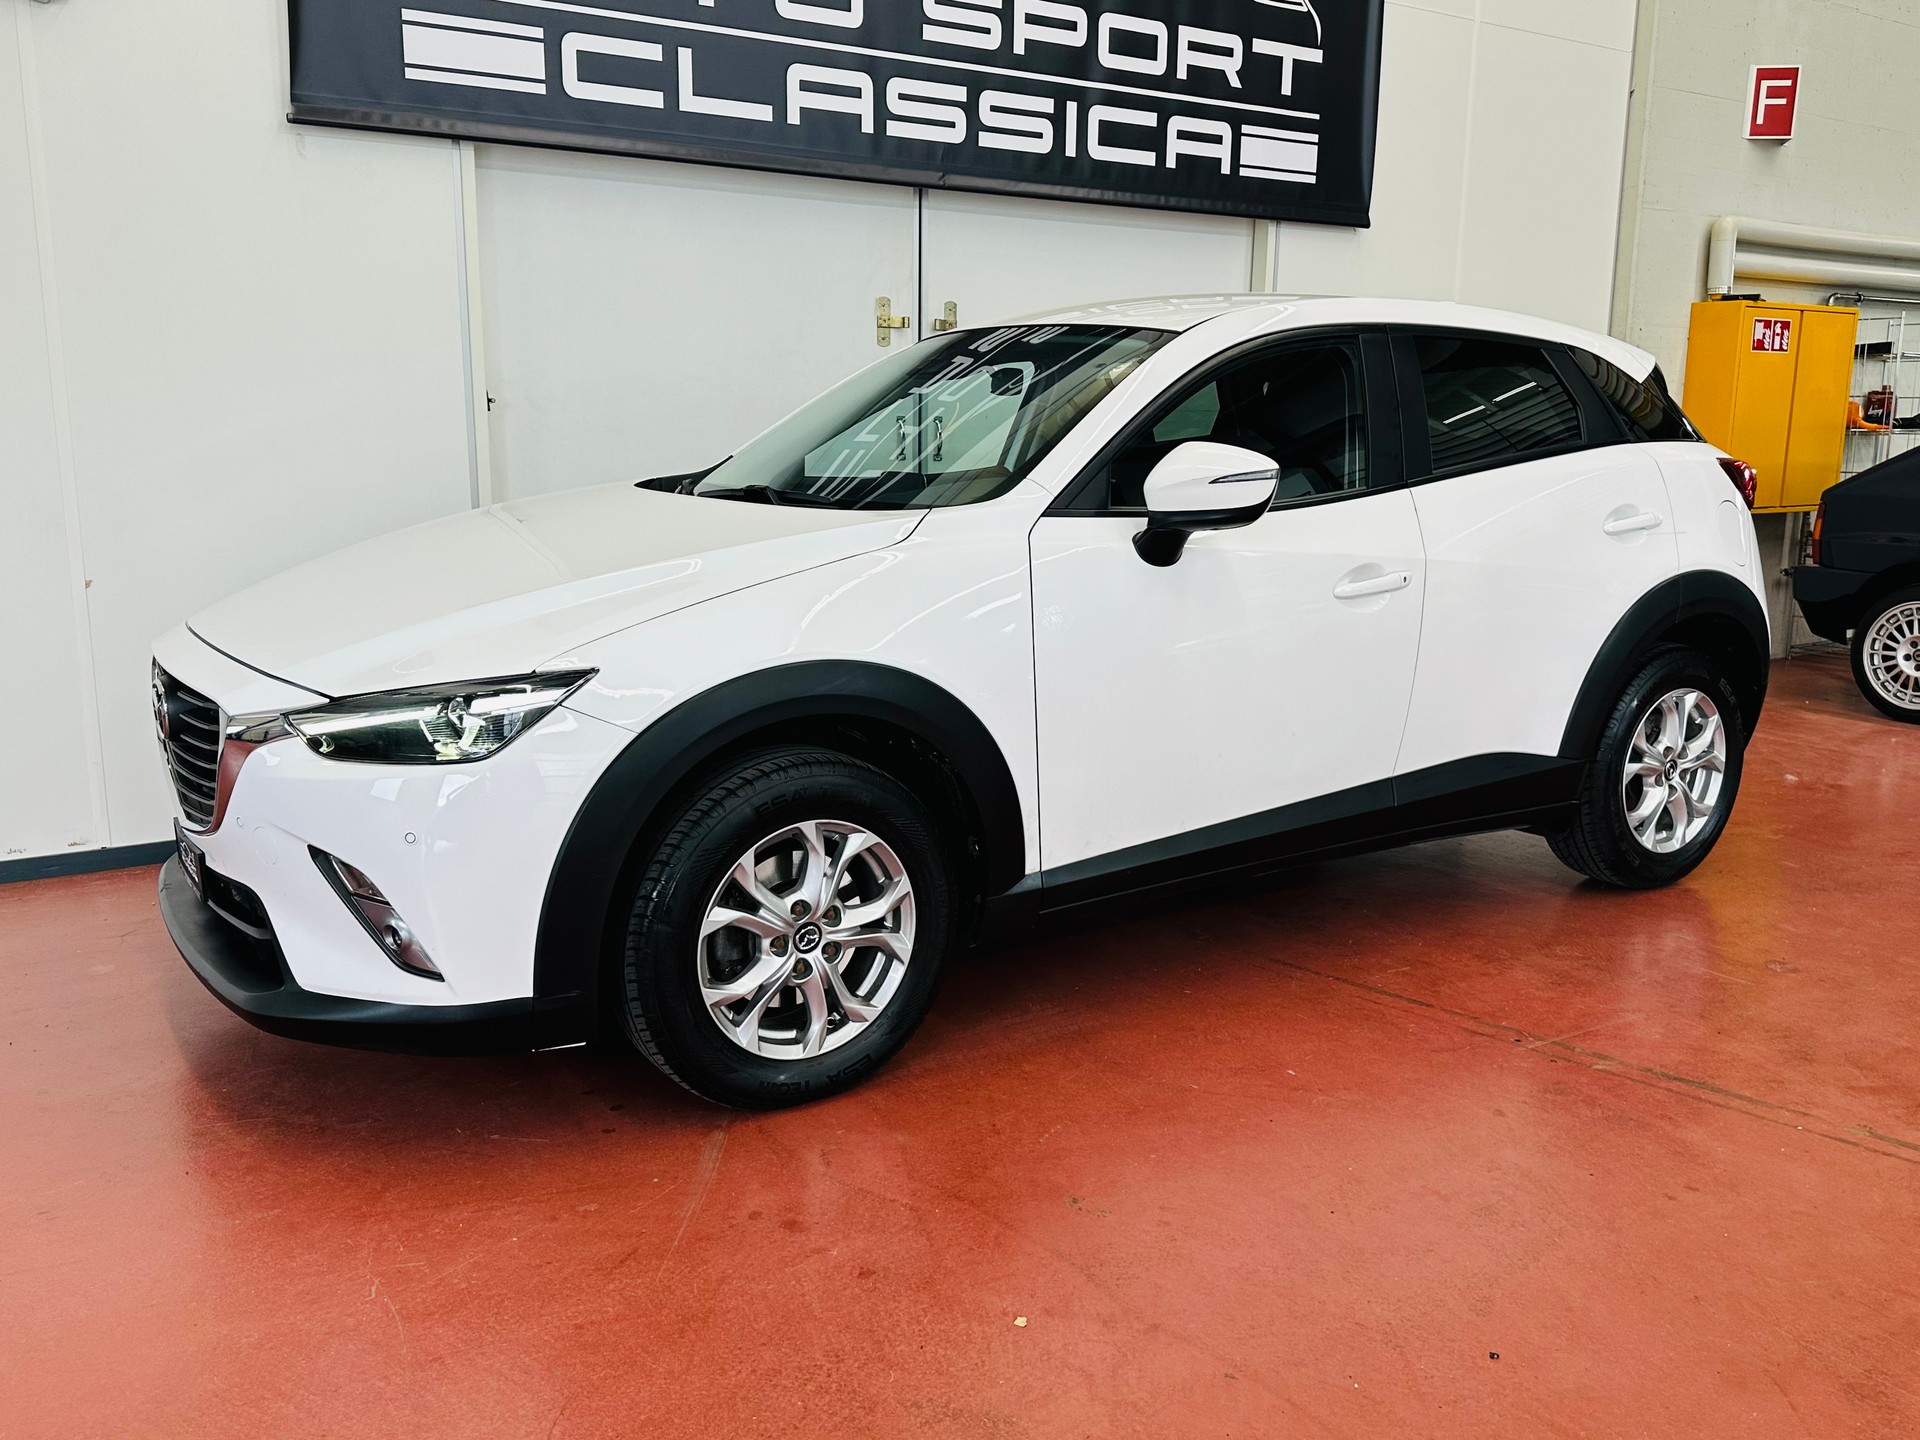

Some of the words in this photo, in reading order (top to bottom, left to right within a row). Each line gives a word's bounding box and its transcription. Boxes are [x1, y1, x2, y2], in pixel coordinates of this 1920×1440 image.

[922, 0, 1324, 96] SPORT
[561, 32, 1233, 175] CLASSICA
[1755, 79, 1793, 125] F
